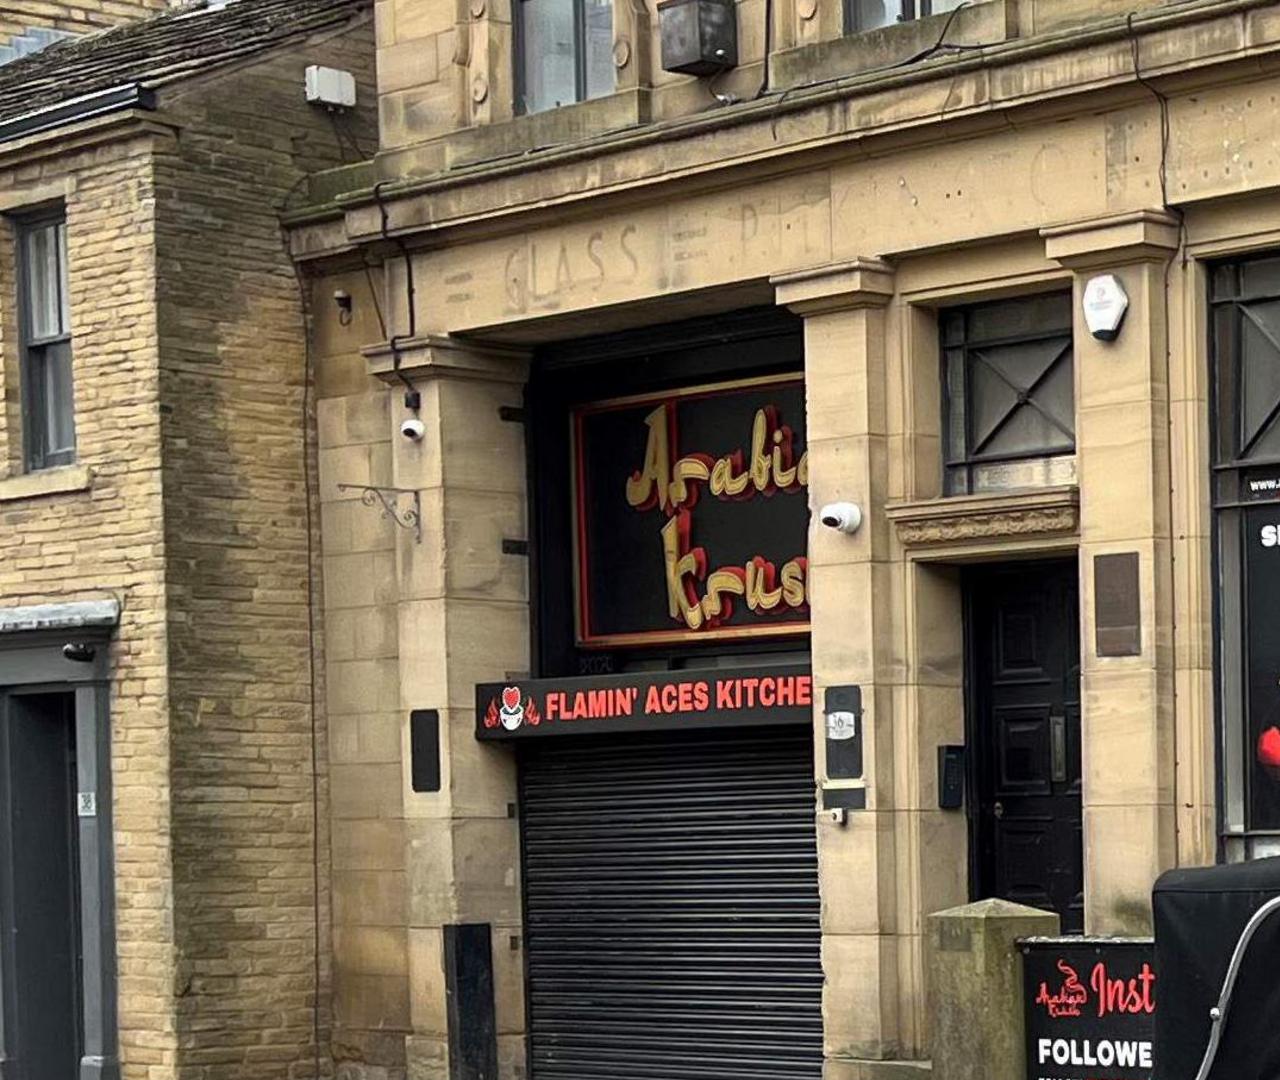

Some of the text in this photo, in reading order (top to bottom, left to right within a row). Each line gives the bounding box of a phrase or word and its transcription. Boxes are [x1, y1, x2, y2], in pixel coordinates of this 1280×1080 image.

[504, 223, 639, 312] GLASS
[545, 675, 811, 720] FLAMIN' ACES KITCHE
[1039, 1039, 1152, 1067] FOLLOWE
